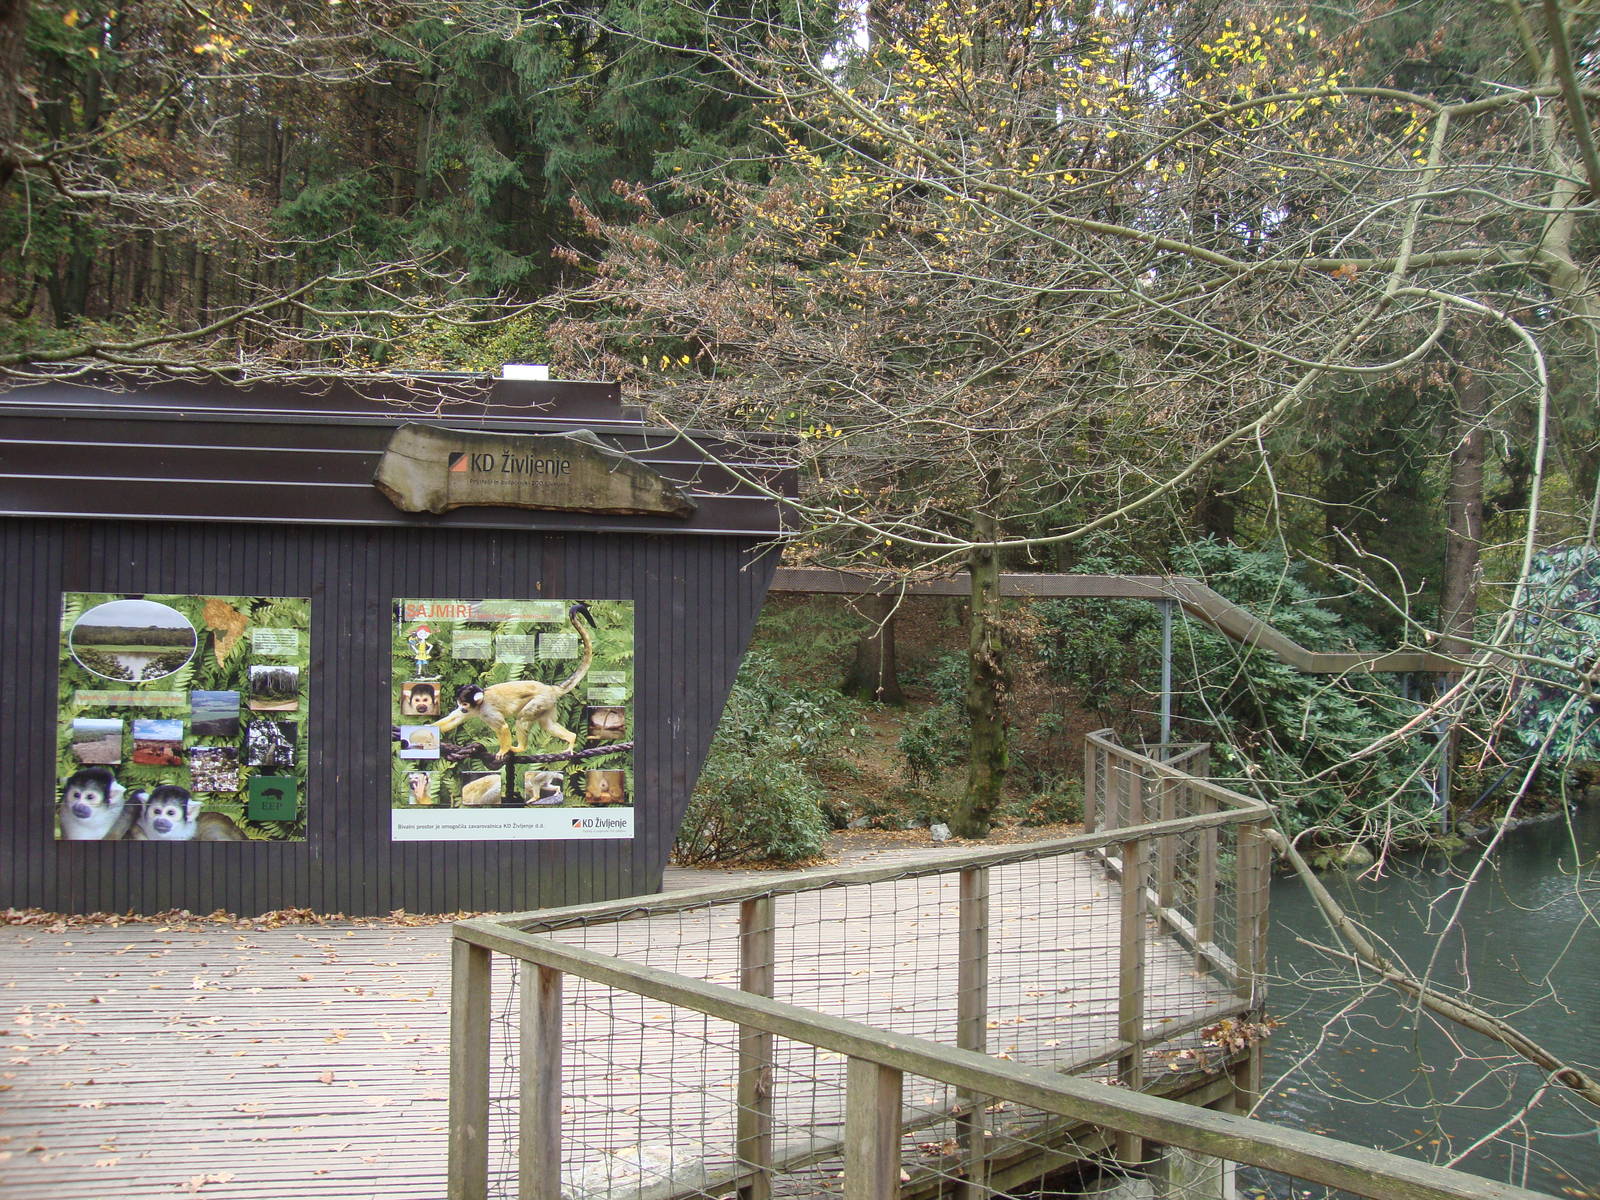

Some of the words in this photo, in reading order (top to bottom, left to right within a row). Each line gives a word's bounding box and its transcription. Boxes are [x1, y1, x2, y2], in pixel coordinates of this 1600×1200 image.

[471, 453, 495, 473] KD
[501, 450, 571, 478] Življenje
[512, 821, 533, 830] Življenje
[582, 819, 593, 828] KD
[595, 817, 627, 829] Življenje
